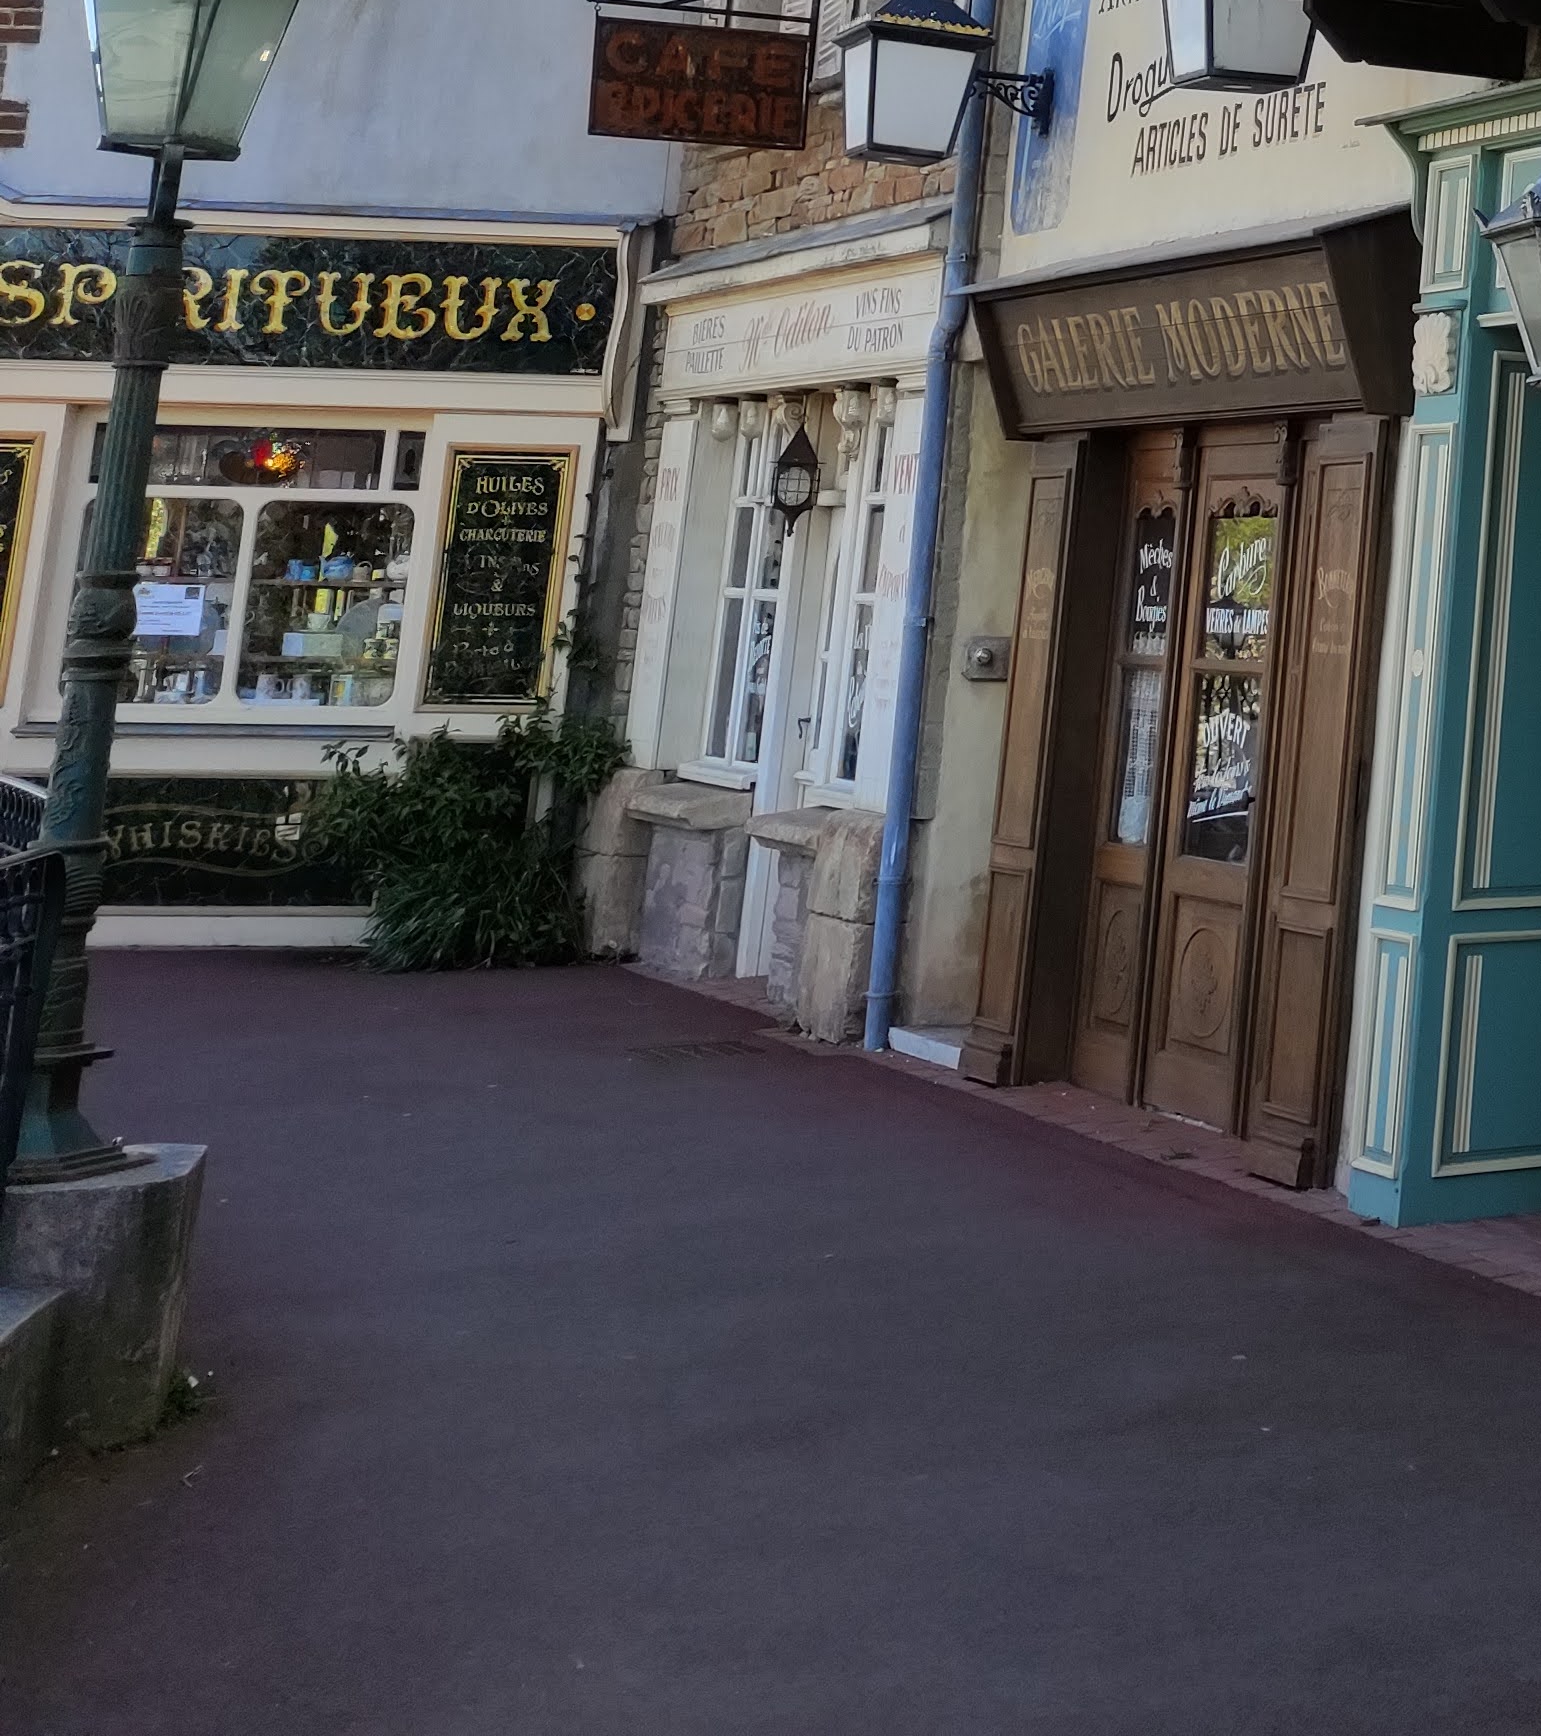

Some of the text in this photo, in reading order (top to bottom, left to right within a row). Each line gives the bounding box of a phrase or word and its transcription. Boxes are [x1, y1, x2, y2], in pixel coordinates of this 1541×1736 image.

[1130, 113, 1208, 176] ARTICLES
[1219, 103, 1242, 157] DE
[0, 259, 562, 342] SPRITUEUX
[856, 290, 877, 319] VINS
[848, 321, 903, 352] DU PATRON
[1018, 282, 1347, 394] GALERIE MODERNE
[475, 477, 545, 495] HUILES
[1139, 539, 1173, 574] Mèches
[1217, 536, 1268, 599] Carbure
[1206, 607, 1234, 635] VERRES
[1242, 607, 1269, 636] LAMPES
[1202, 710, 1251, 749] OUVERT
